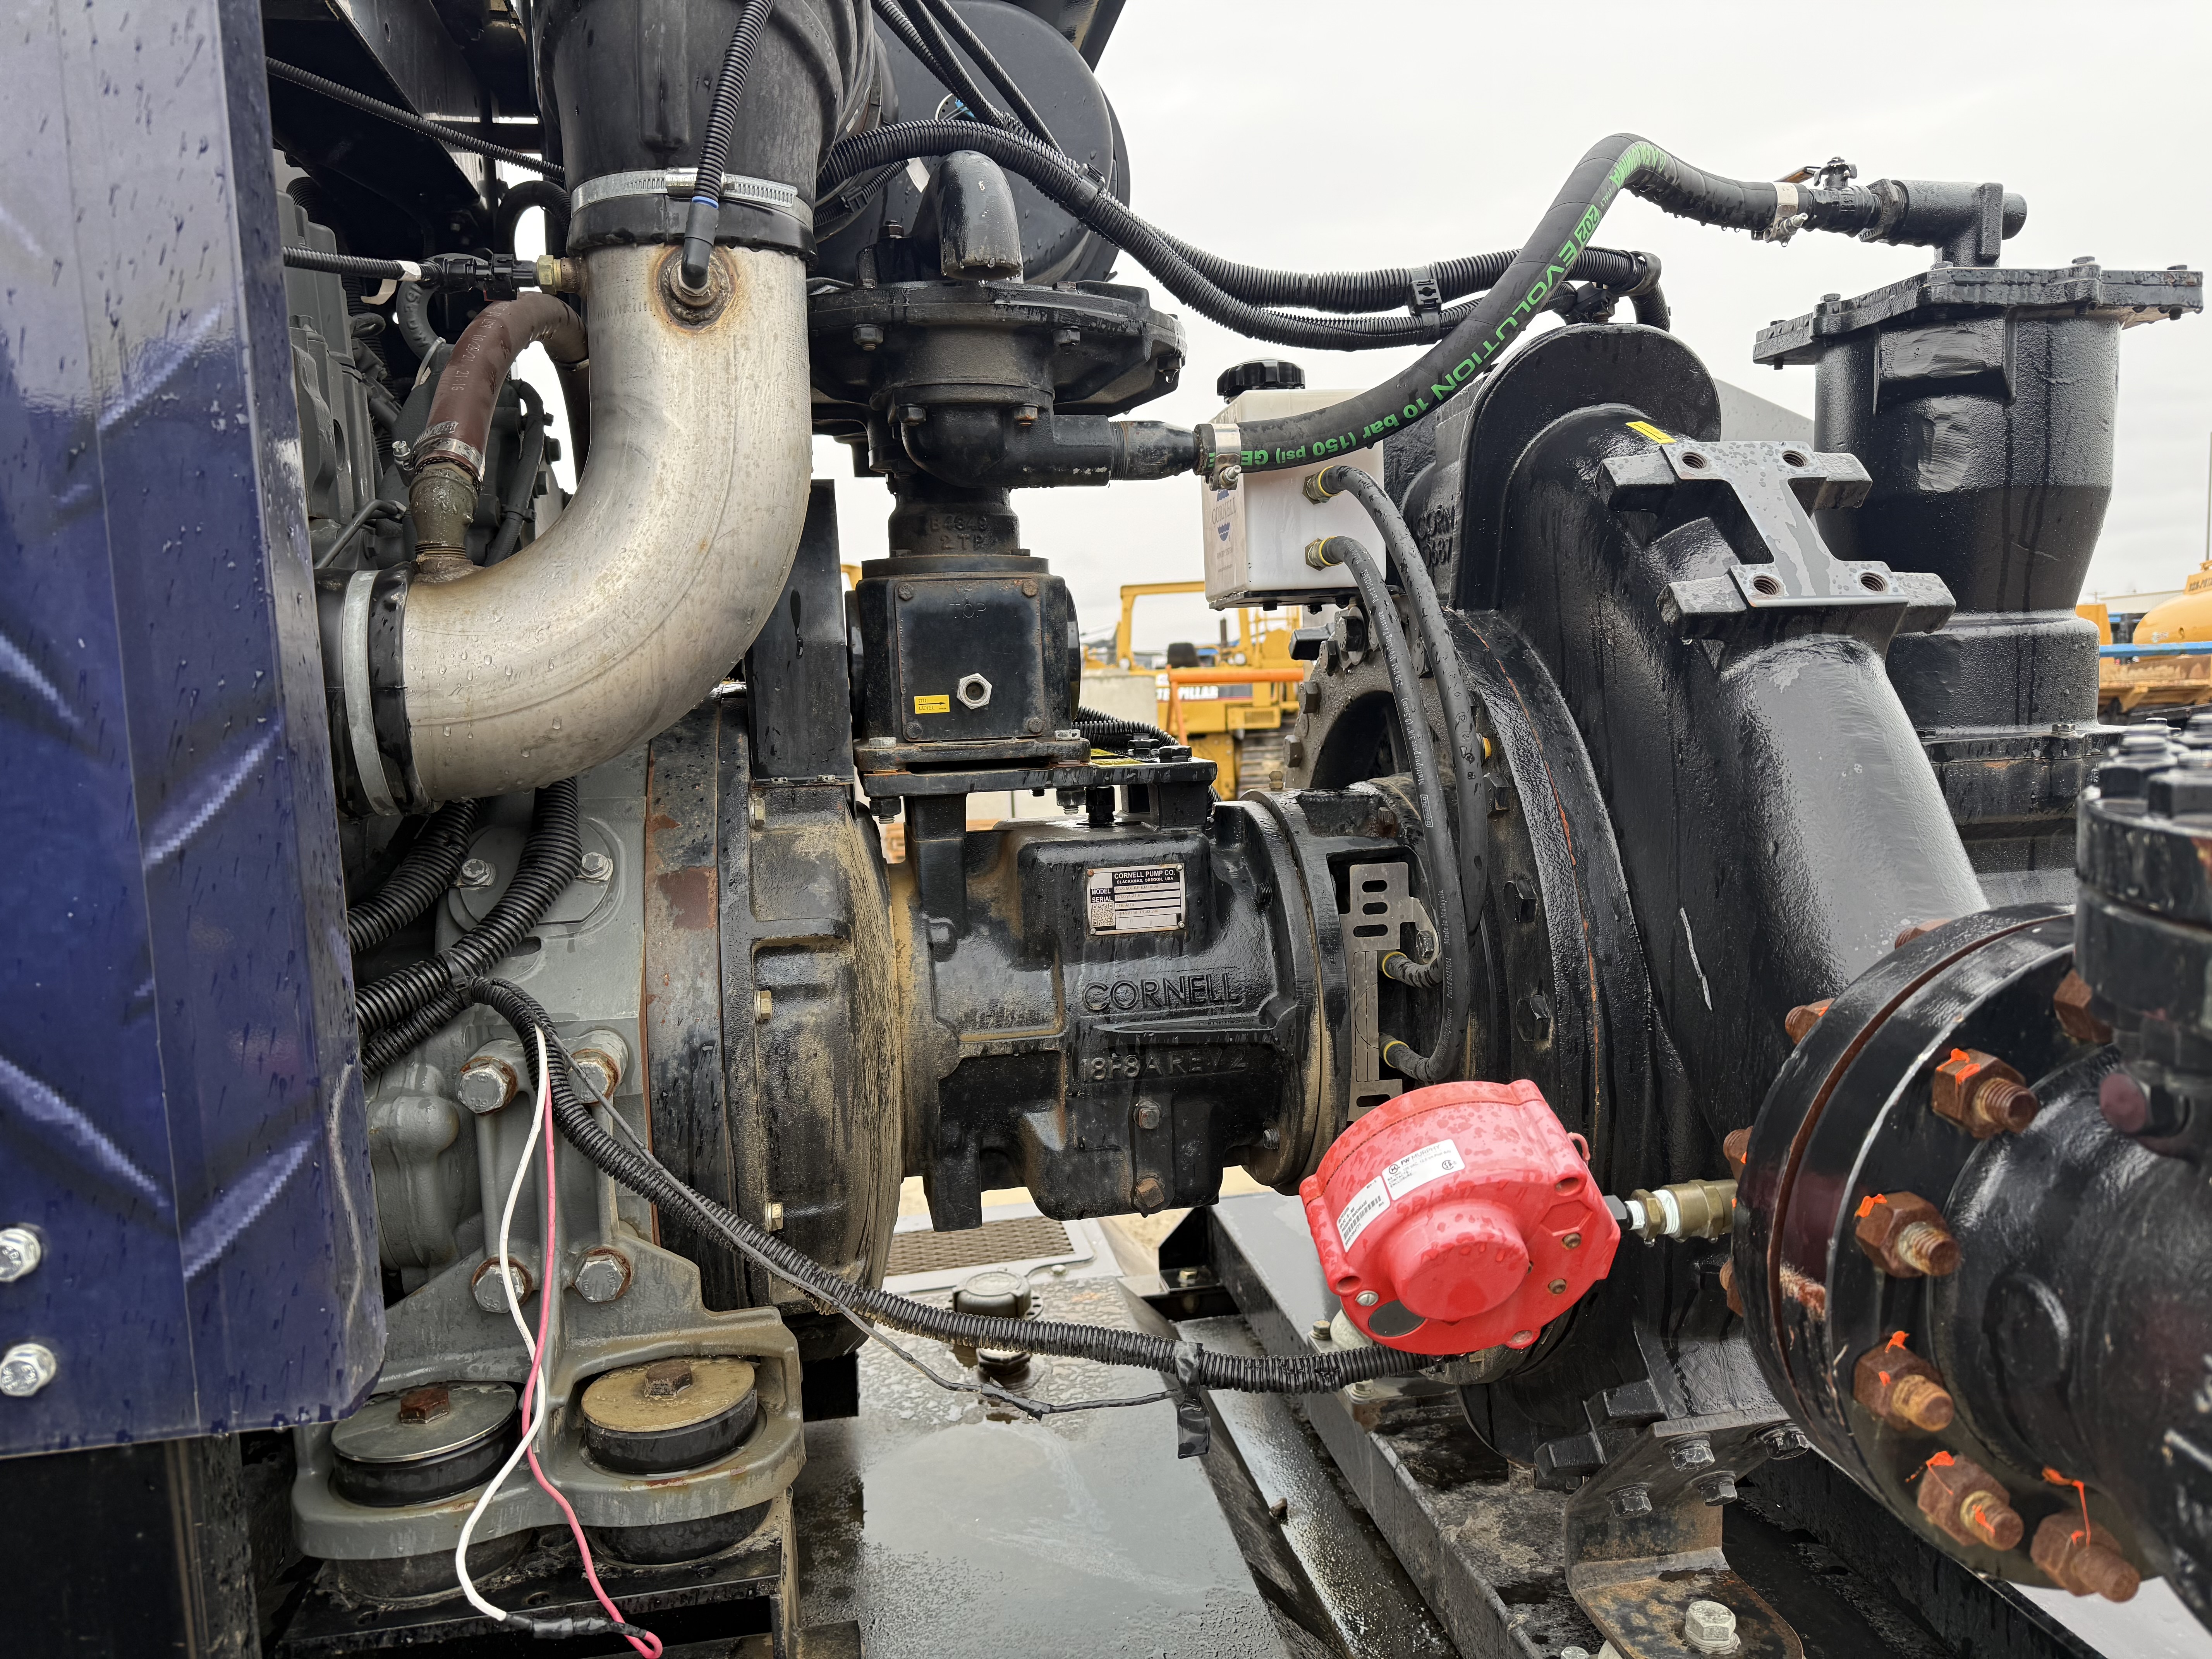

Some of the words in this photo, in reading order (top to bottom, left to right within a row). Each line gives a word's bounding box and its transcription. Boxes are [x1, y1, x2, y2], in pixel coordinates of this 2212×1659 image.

[1577, 207, 1598, 242] 202
[1431, 240, 1578, 400] EVOLUTION
[451, 371, 469, 390] 21:16
[1403, 398, 1429, 418] 10
[1363, 414, 1400, 439] bar
[1276, 446, 1306, 464] psi)
[1312, 432, 1356, 456] (150
[1212, 497, 1237, 525] CORNELL
[1379, 611, 1389, 634] Pressure
[1386, 634, 1396, 661] Working
[1394, 674, 1403, 687] 250
[1400, 698, 1413, 725] (9.5mm)
[1411, 740, 1424, 785] Multipurpose
[1082, 972, 1239, 1011] CORNELL
[1400, 1157, 1410, 1165] FW
[1411, 1144, 1440, 1161] MURPHY
